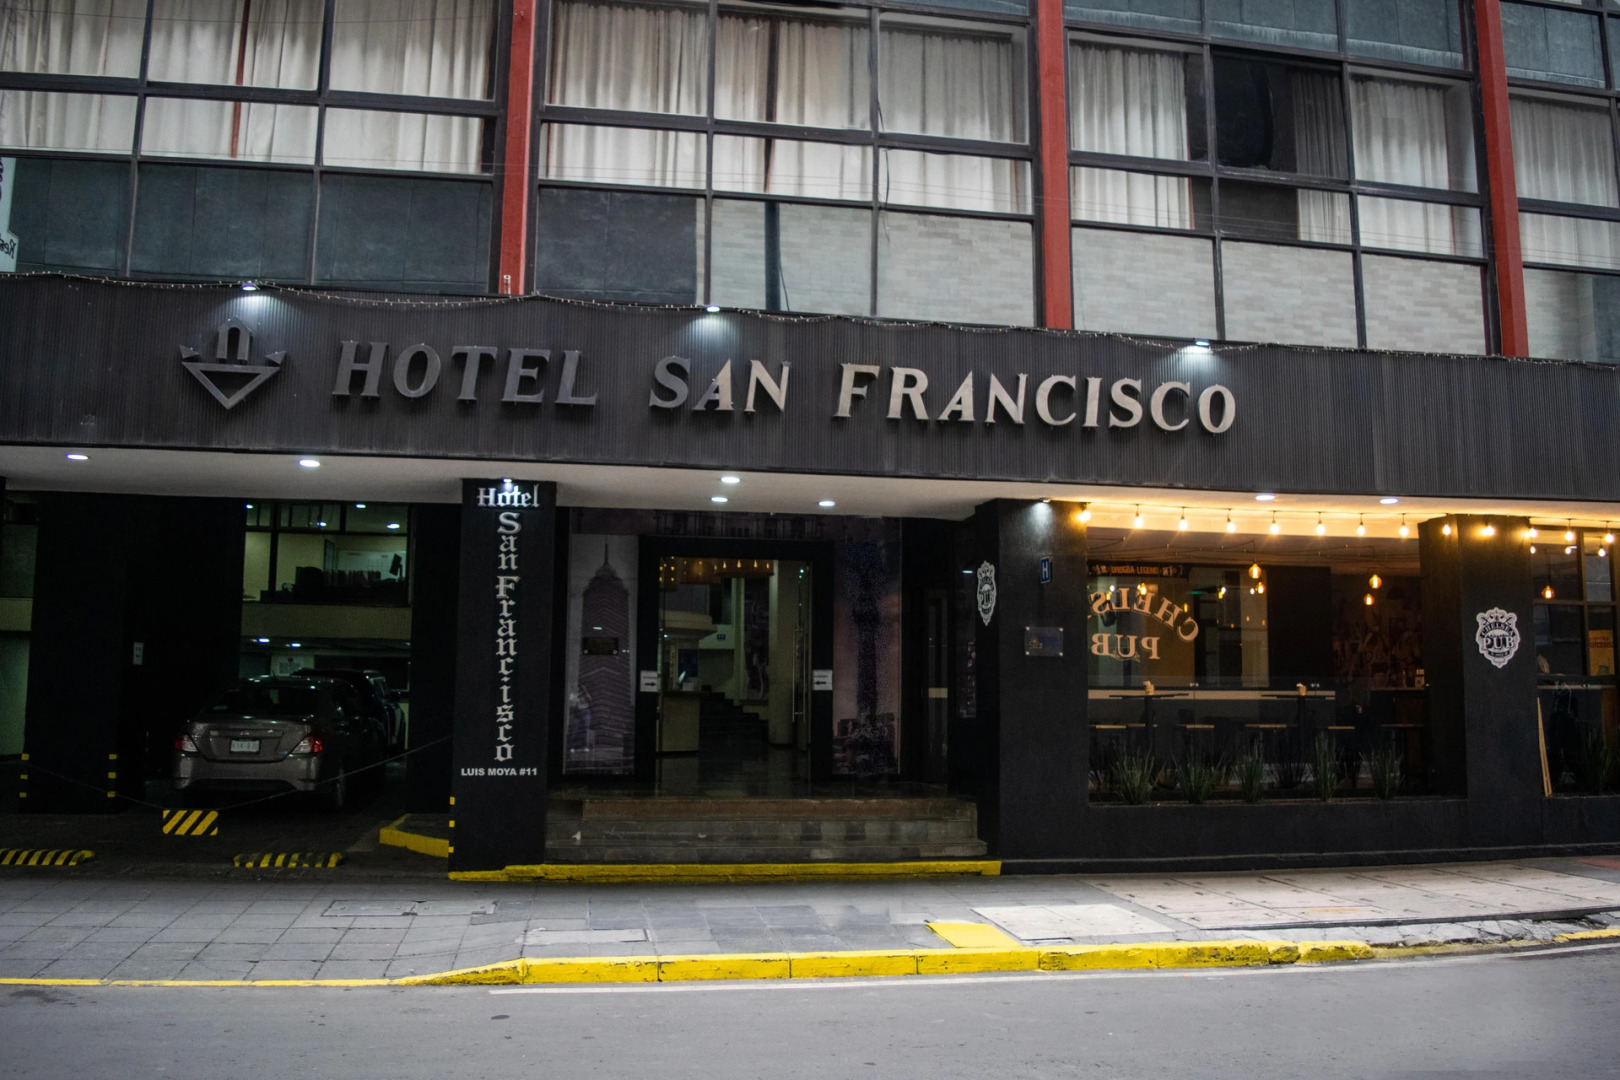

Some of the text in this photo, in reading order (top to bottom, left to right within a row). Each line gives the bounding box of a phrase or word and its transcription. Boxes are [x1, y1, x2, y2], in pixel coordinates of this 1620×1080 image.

[331, 340, 1236, 434] HOTEL SAN FRANCISCO
[476, 484, 540, 508] Hotel
[1042, 561, 1049, 579] H
[494, 511, 522, 762] San Francisco
[1483, 635, 1514, 650] PUB
[461, 768, 537, 776] LUIS MOYA #11
